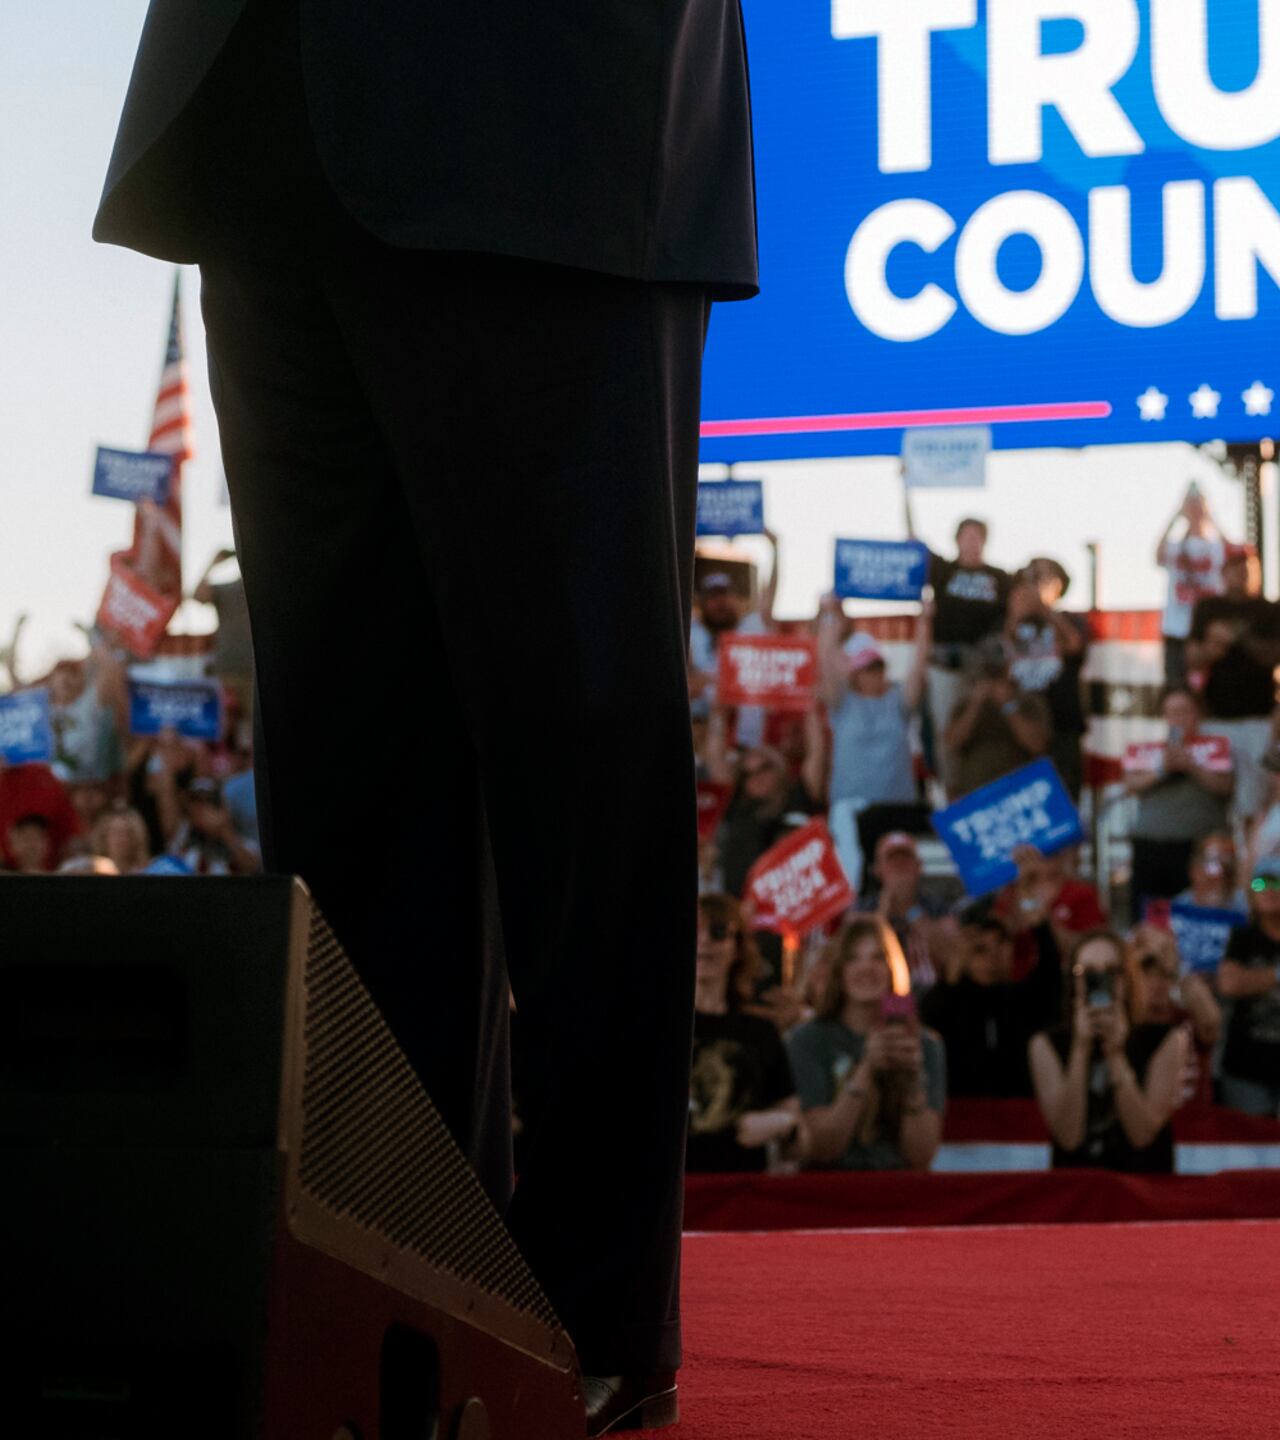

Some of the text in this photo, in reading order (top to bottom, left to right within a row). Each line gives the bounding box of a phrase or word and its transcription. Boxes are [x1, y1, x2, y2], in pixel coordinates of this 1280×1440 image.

[727, 645, 809, 670] TRUMP
[952, 779, 1052, 844] TRUMP
[979, 809, 1050, 858] 2024
[753, 839, 824, 900] TRUMP
